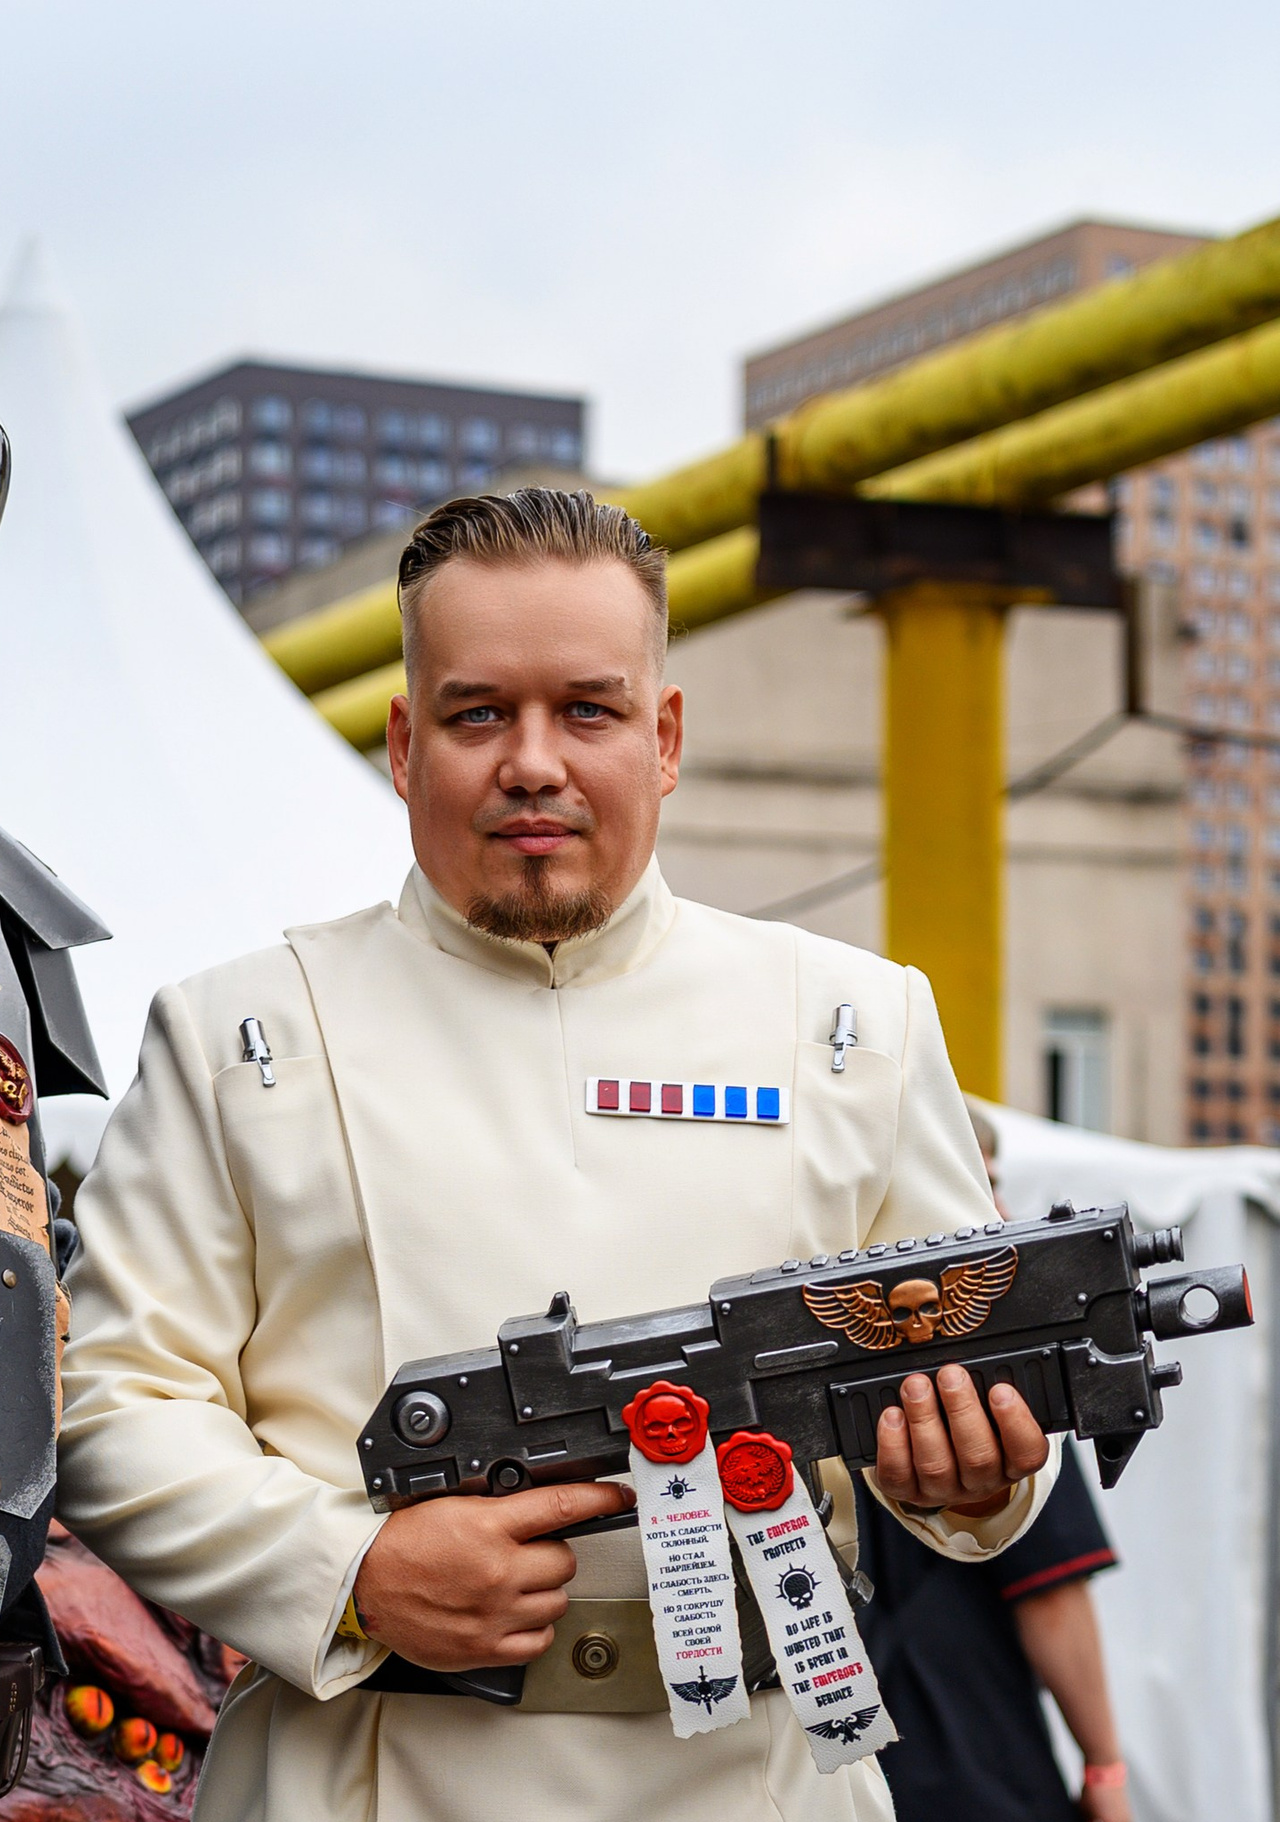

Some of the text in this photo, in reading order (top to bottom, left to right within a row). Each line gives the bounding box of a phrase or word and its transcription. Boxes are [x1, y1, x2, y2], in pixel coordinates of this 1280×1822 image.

[646, 1531, 669, 1540] ХОТЬ
[678, 1524, 722, 1535] СЛАБОСТИ
[746, 1515, 810, 1546] THE EMPEROR
[669, 1551, 705, 1563] НО СТАЛ
[763, 1537, 806, 1561] PROTECTS
[652, 1574, 729, 1591] И СЛАБОСТЬ ЗДЕСЬ
[664, 1606, 675, 1614] НО
[684, 1599, 724, 1611] СОКРУШУ
[674, 1612, 716, 1623] СЛАБОСТЬ
[785, 1611, 833, 1636] NO LIFE IS
[672, 1624, 721, 1638] ВСЕЙ СИЛОЙ
[685, 1636, 711, 1646] СВОЕЙ
[784, 1626, 846, 1657] WASTED THAT
[676, 1646, 723, 1660] ГОРДОСТИ
[795, 1647, 849, 1674] IS SPENT IN
[792, 1679, 812, 1695] THE
[815, 1685, 854, 1708] SERVICE
